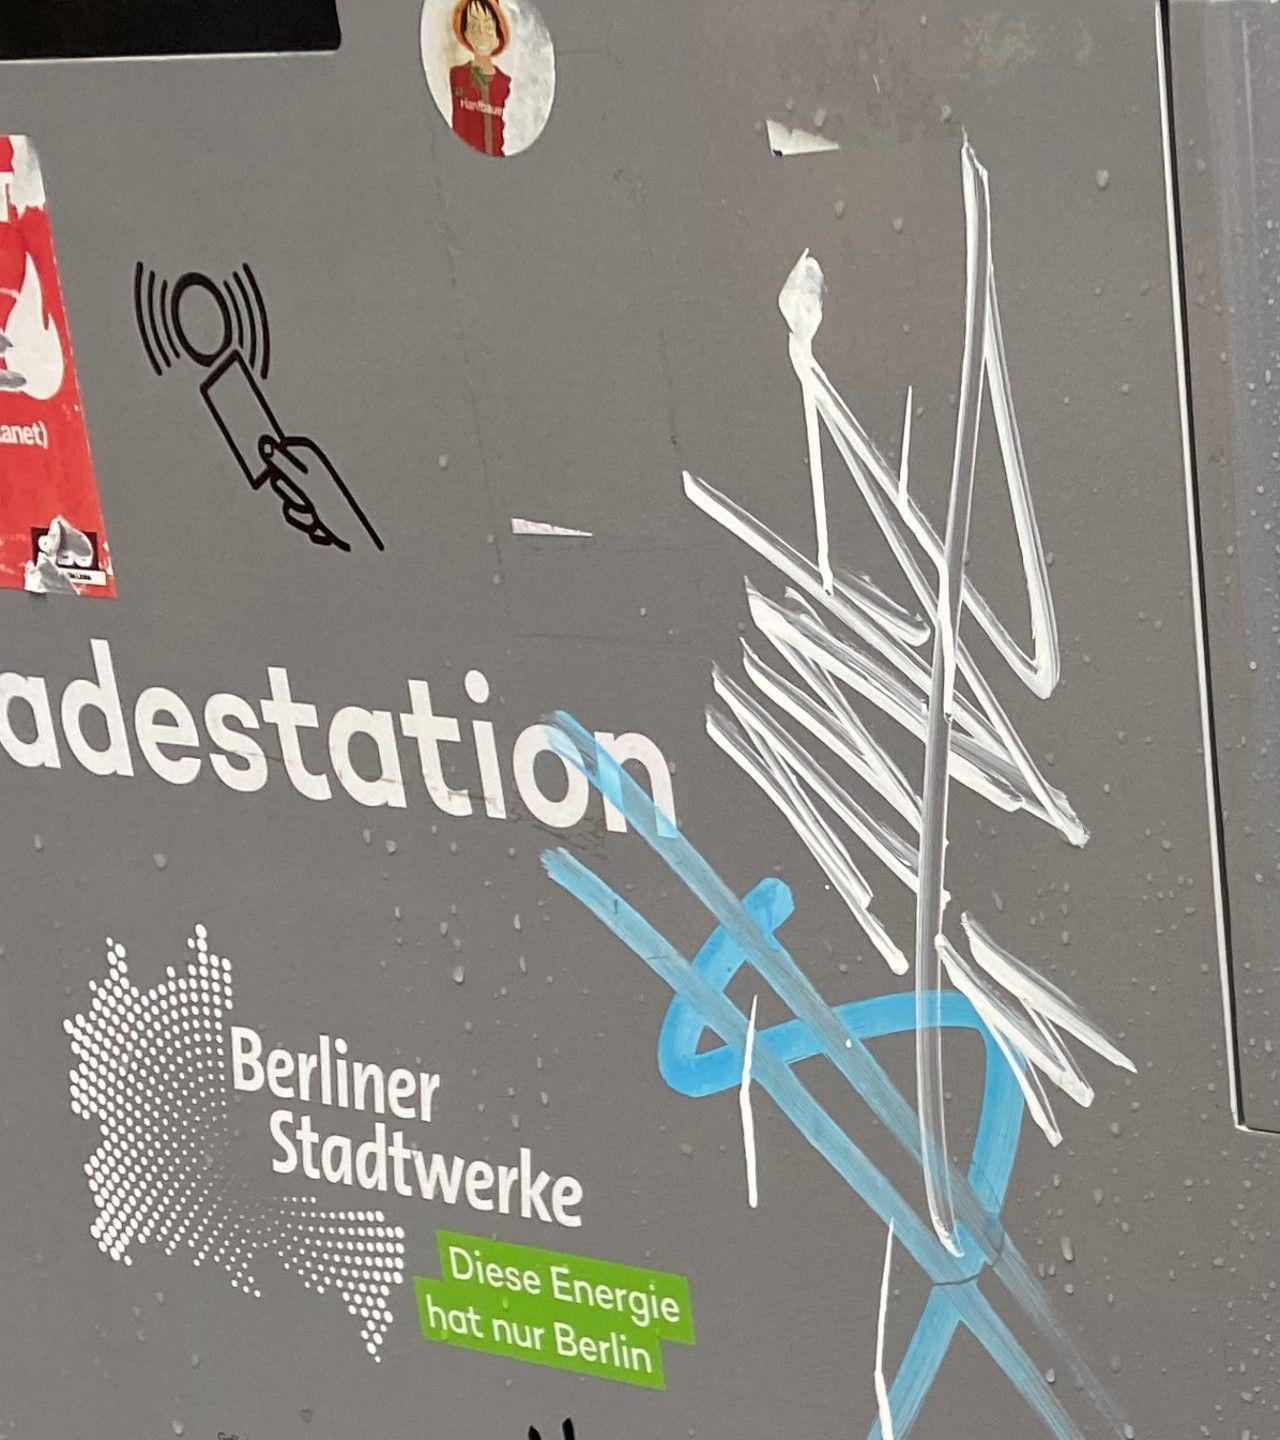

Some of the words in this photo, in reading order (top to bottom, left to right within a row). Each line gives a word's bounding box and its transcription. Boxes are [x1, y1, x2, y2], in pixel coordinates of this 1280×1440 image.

[0, 420, 49, 449] anet)
[0, 637, 678, 838] adestation
[230, 1026, 440, 1123] Berliner
[270, 1109, 583, 1228] Stadtwerke
[449, 1245, 541, 1295] Diese
[553, 1264, 680, 1329] Energie
[426, 1294, 483, 1340] hat
[492, 1317, 544, 1351] nur
[556, 1320, 652, 1374] Berlin
